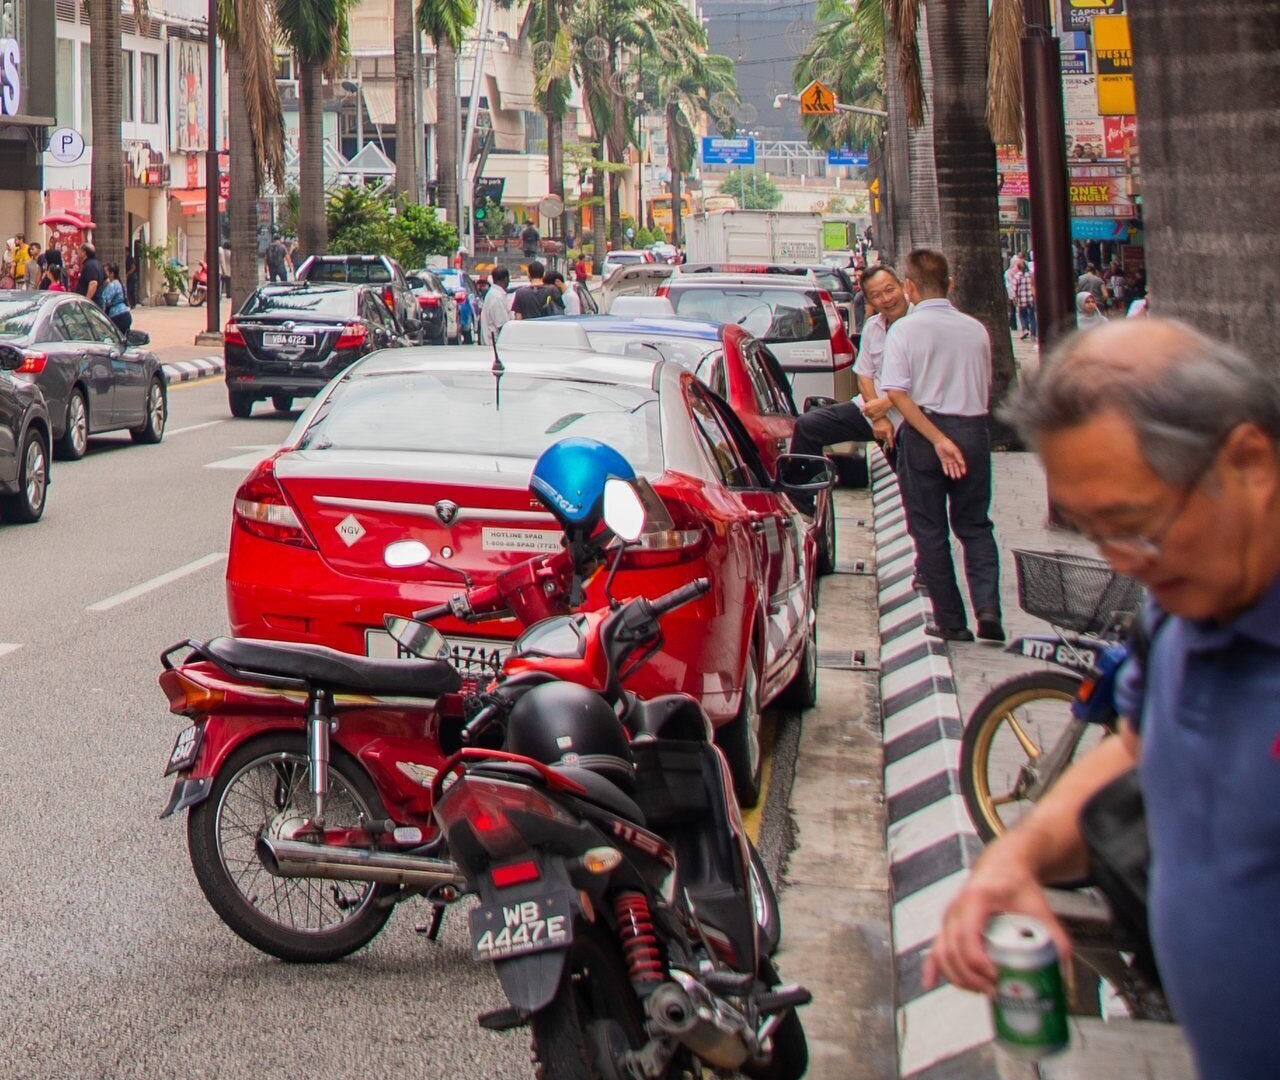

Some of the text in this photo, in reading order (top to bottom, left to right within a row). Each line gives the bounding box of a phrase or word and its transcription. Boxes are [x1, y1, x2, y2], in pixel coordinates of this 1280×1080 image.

[1070, 194, 1109, 202] ANGER
[340, 525, 360, 535] NGV
[503, 901, 540, 927] WB
[476, 915, 566, 951] 4447E
